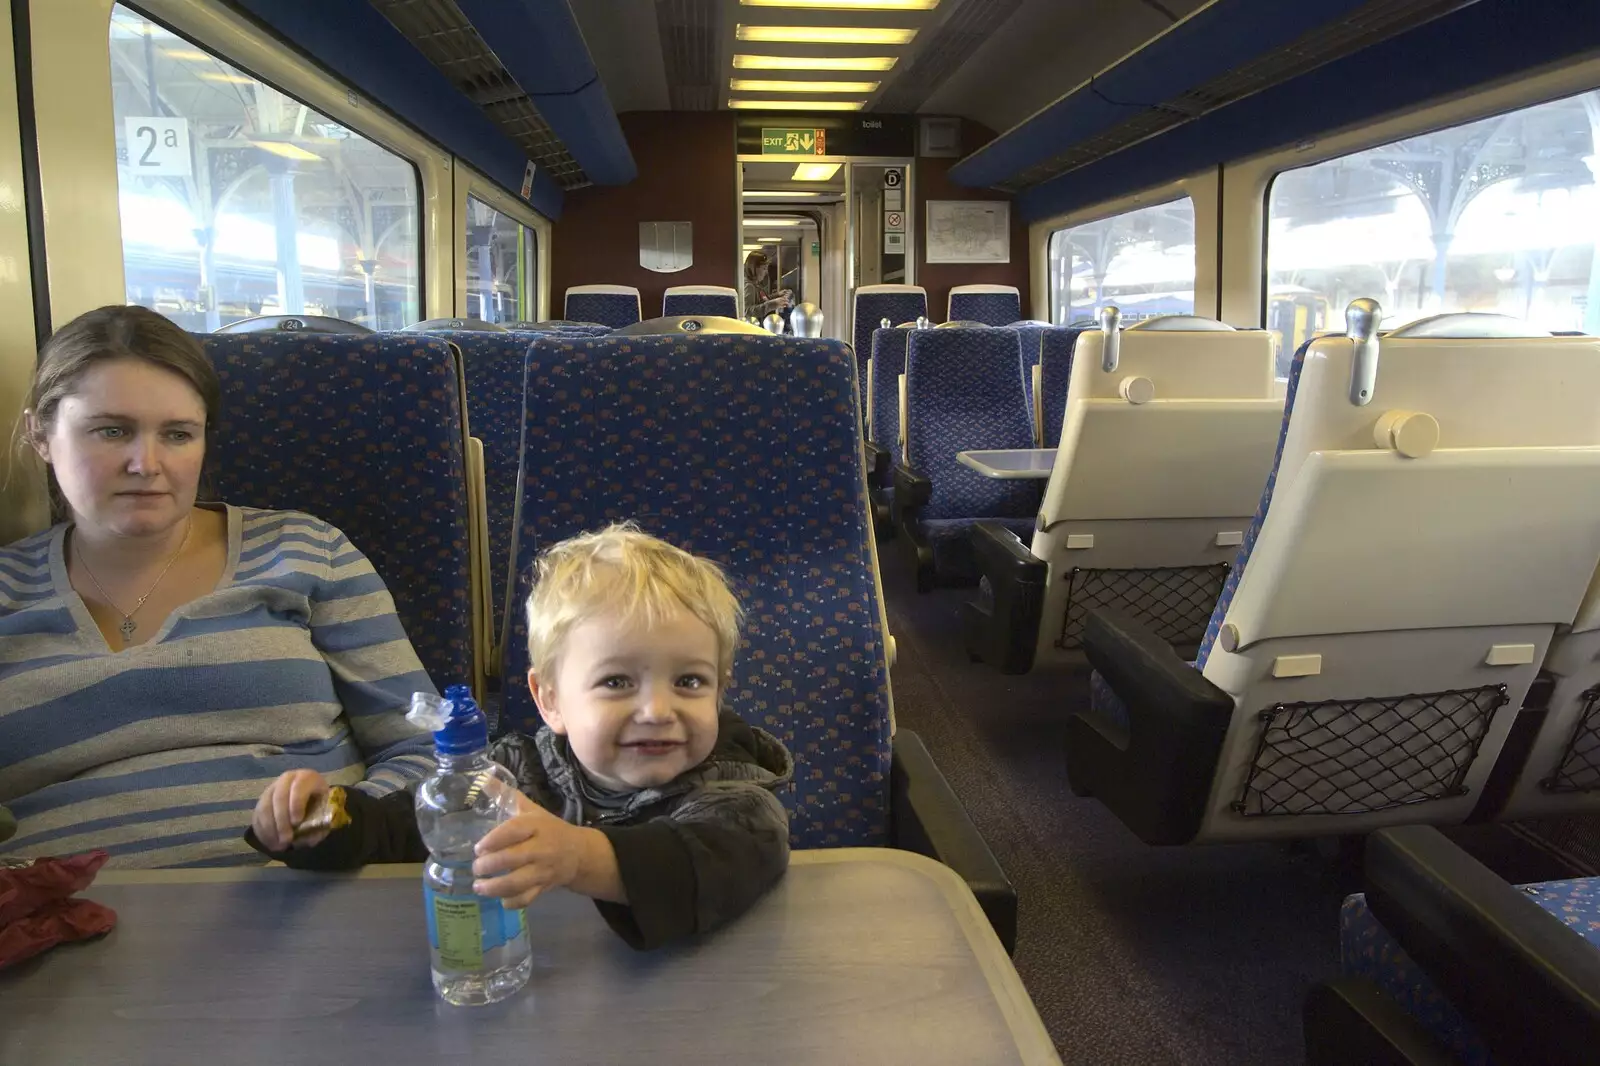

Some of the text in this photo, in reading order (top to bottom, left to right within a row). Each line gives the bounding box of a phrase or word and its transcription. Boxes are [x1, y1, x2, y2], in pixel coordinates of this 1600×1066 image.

[862, 120, 882, 129] toilet
[763, 137, 784, 146] EXIT
[888, 174, 897, 185] D
[685, 322, 696, 330] 23
